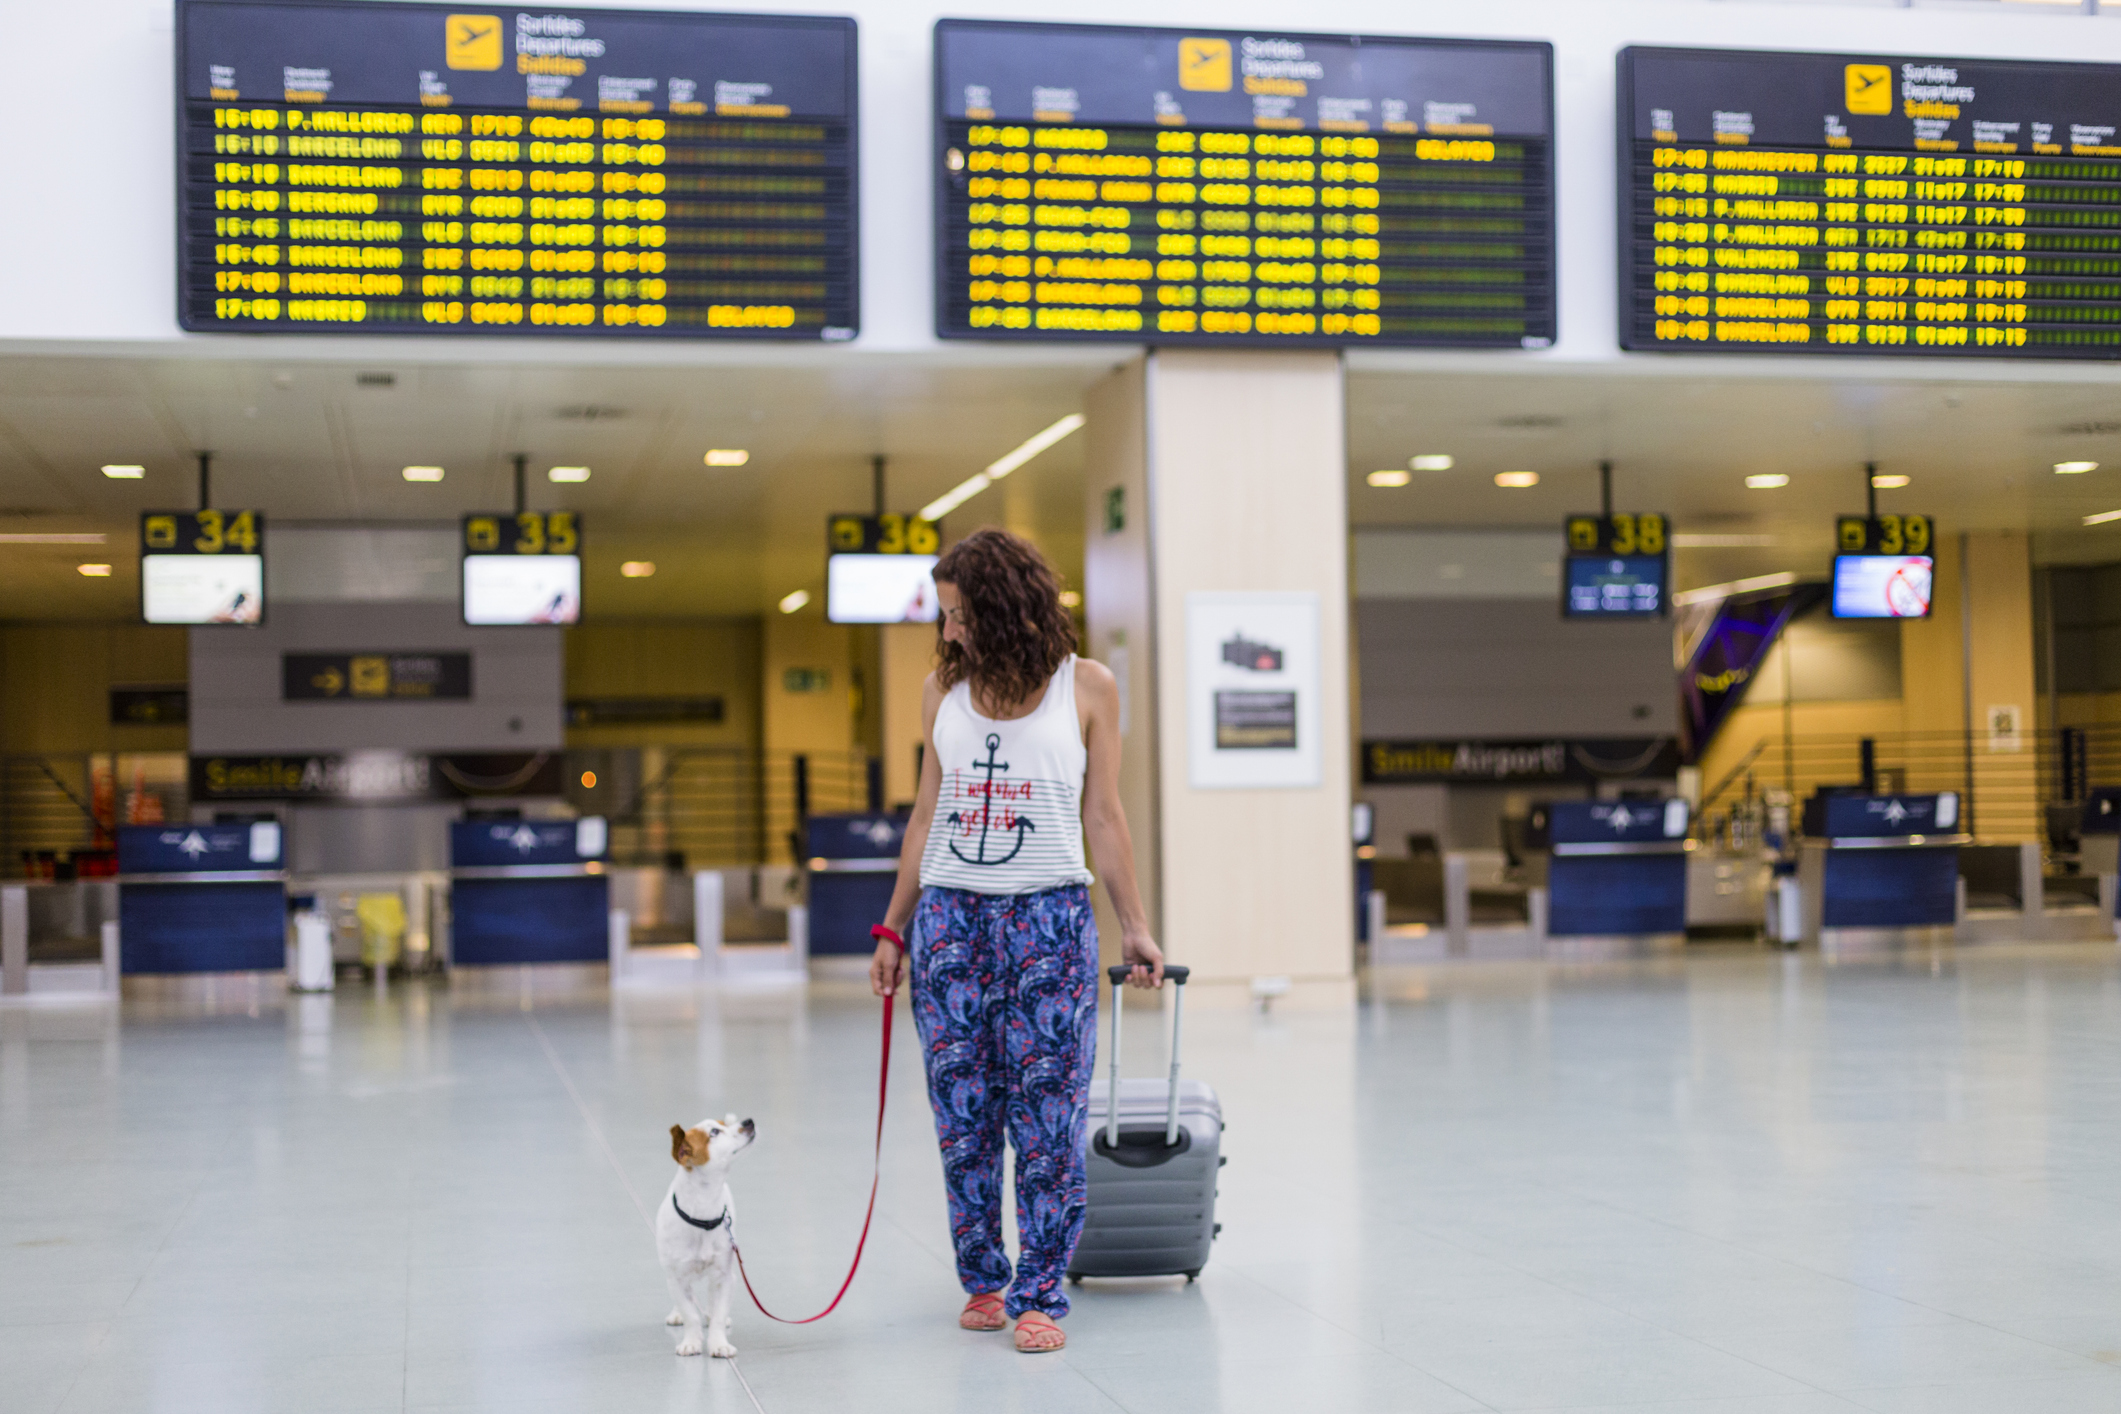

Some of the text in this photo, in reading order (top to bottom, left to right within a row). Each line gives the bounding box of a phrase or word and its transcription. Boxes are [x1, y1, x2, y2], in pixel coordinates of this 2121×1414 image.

[516, 14, 585, 36] Sortides
[516, 34, 604, 57] Departures
[518, 53, 586, 75] Salidas
[1242, 56, 1323, 79] Departures
[1902, 63, 1957, 85] Sortides
[1903, 81, 1974, 103] Departures
[1905, 100, 1960, 120] Salidas
[196, 509, 256, 553] 34
[517, 511, 576, 554] 35
[878, 513, 938, 553] 36
[1613, 514, 1665, 554] 38
[1880, 514, 1930, 554] 39
[960, 803, 989, 837] get
